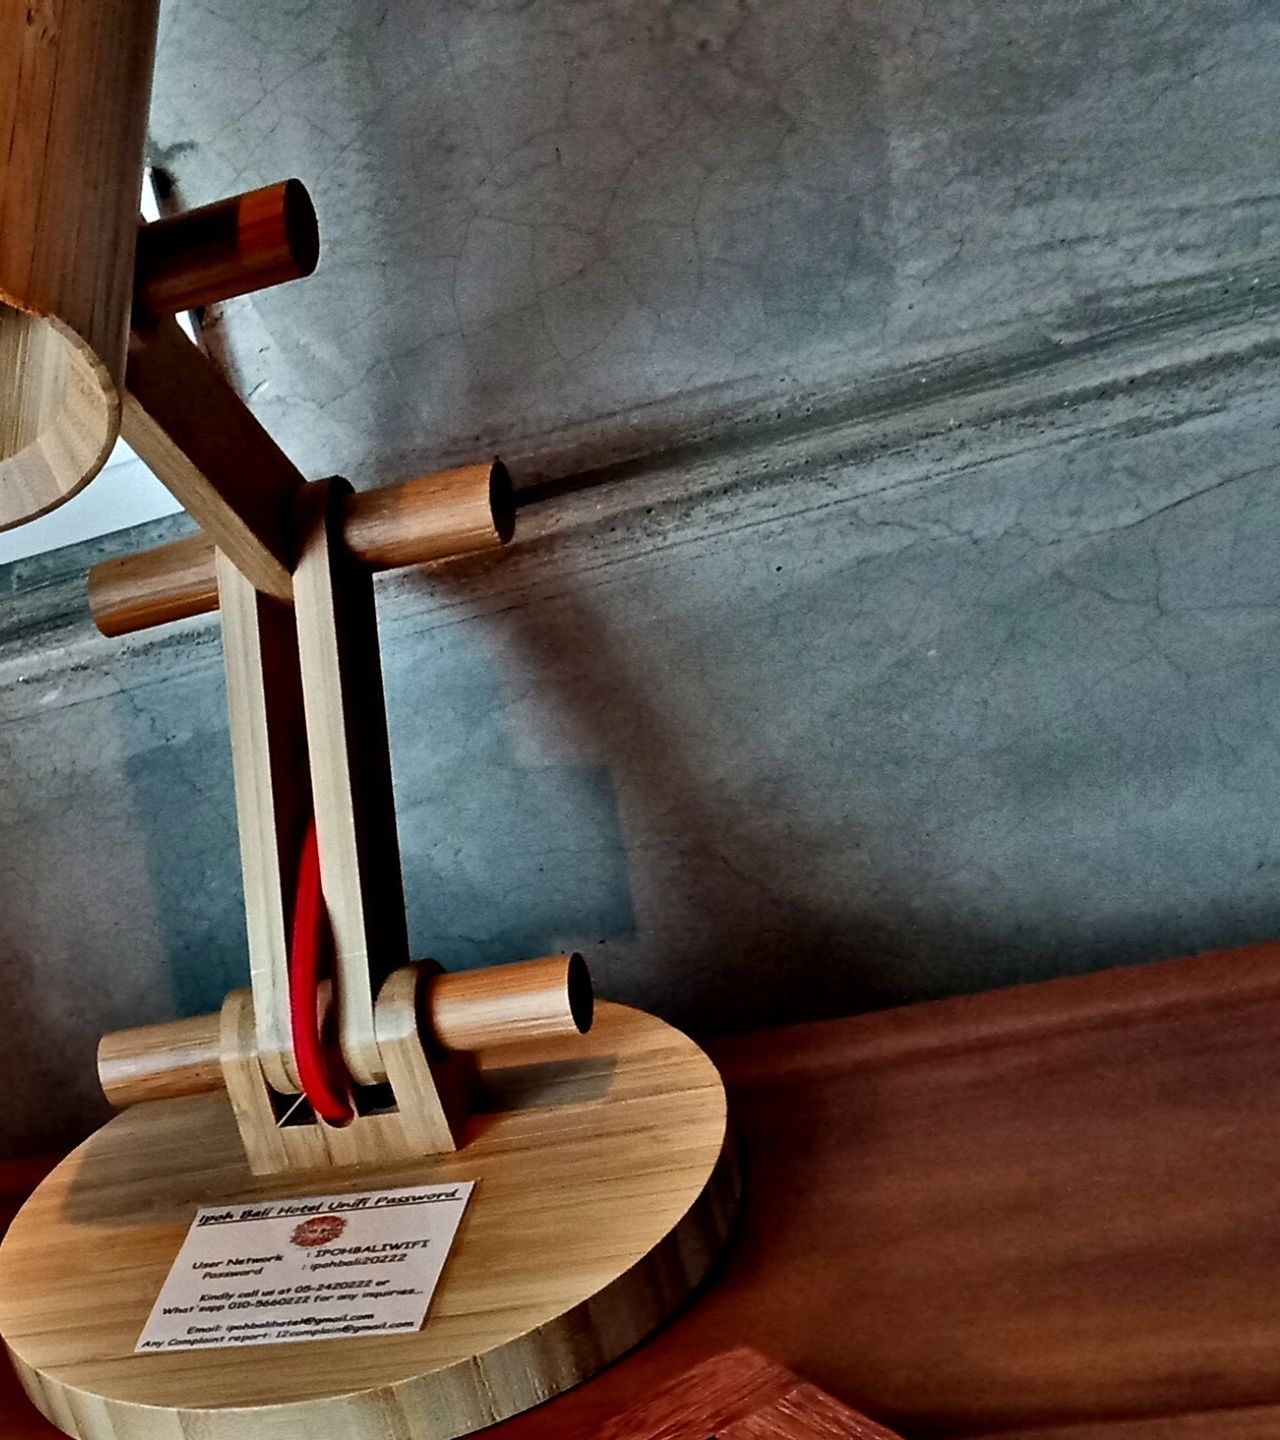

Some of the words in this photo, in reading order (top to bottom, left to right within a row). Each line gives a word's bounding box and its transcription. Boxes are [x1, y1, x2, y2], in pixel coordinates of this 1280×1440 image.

[198, 1212, 234, 1223] Ipoh
[240, 1207, 274, 1220] Bali
[277, 1202, 323, 1215] Hotel
[375, 1188, 459, 1206] Password
[192, 1260, 223, 1270] User
[226, 1254, 284, 1266] Network
[314, 1239, 430, 1258] IPOHBALIWIFI
[202, 1267, 265, 1280] Password
[199, 1291, 236, 1303] Kindly
[238, 1290, 260, 1298] call
[277, 1288, 292, 1296] at
[294, 1279, 372, 1295] 05-2420222
[375, 1279, 391, 1287] or
[313, 1294, 335, 1303] for
[336, 1292, 359, 1301] any
[141, 1339, 165, 1348] Any
[167, 1334, 226, 1347] Complaint
